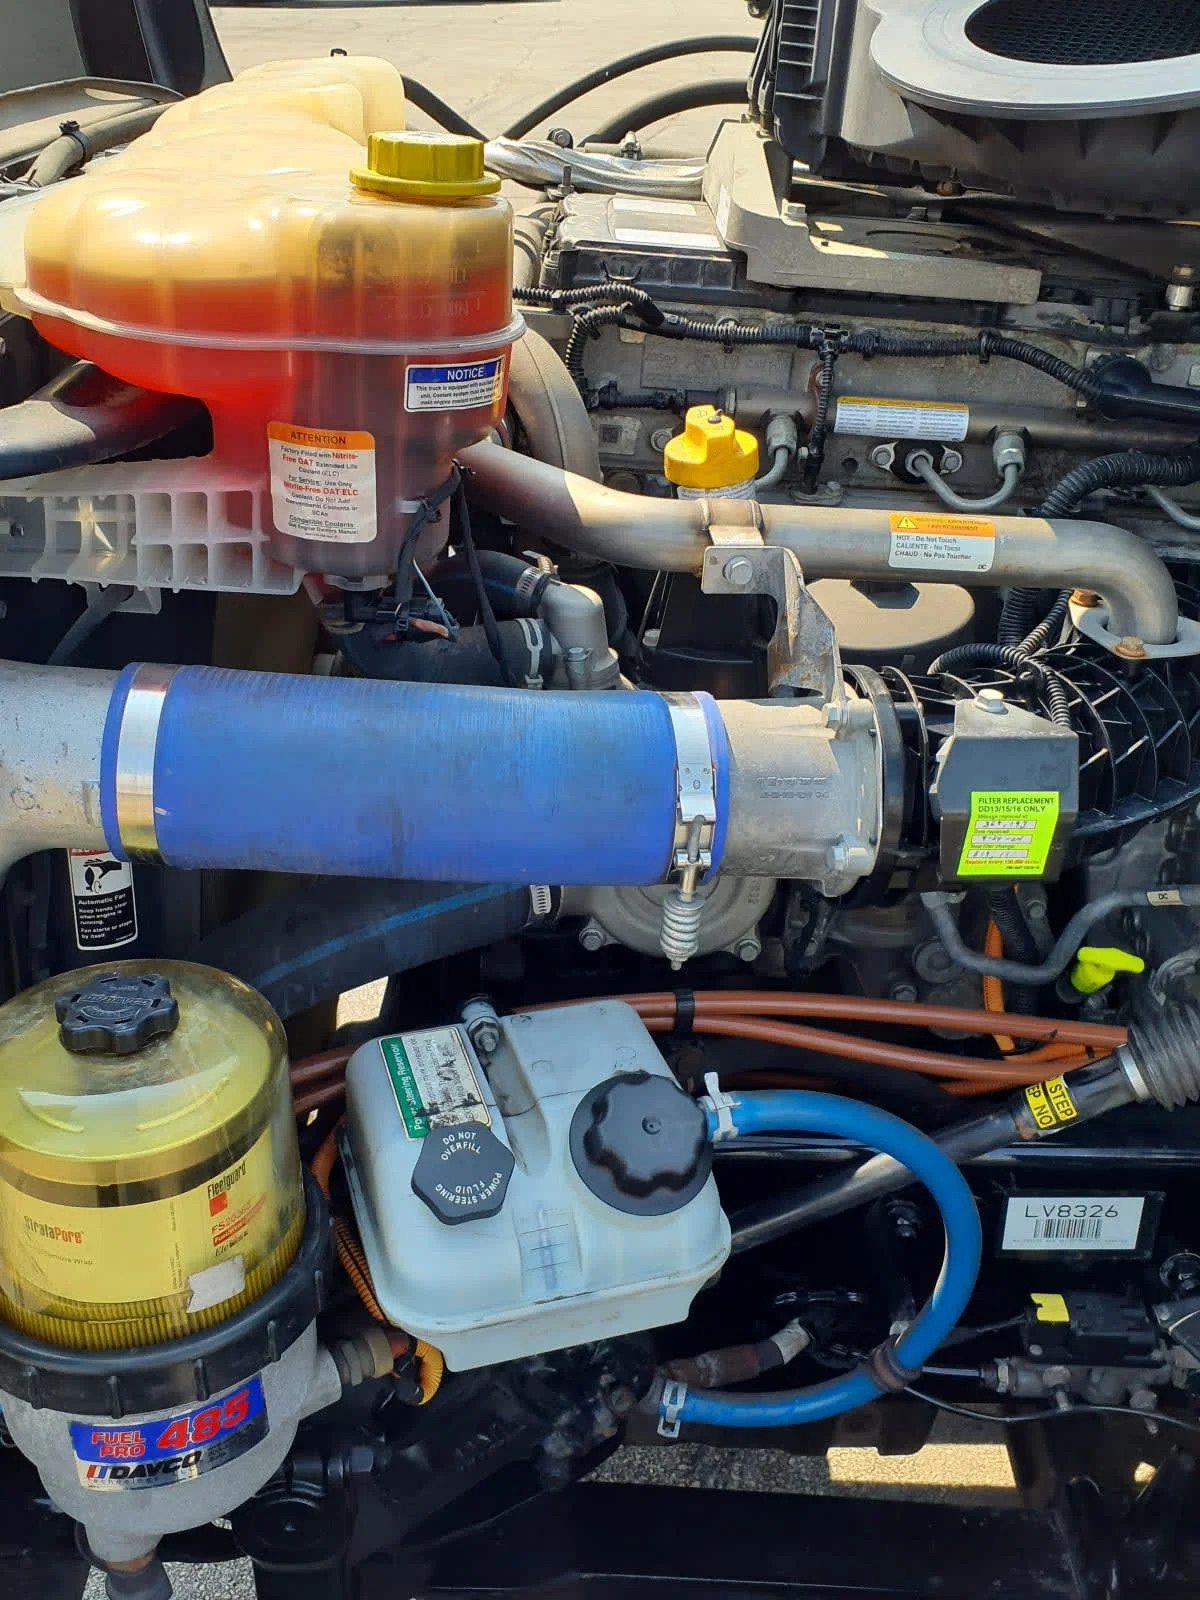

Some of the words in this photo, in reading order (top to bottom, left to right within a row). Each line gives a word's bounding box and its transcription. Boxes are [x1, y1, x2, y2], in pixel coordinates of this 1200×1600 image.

[447, 366, 485, 380] NOTICE
[290, 431, 346, 445] ATTENTION
[282, 454, 297, 463] Free
[298, 457, 314, 466] OAT
[338, 480, 352, 488] Only
[322, 488, 340, 496] OAT
[342, 488, 359, 496] ELC
[78, 896, 113, 905] Automatic
[114, 893, 126, 901] Fan
[118, 920, 133, 928] stops
[390, 1043, 407, 1076] Reservoir
[400, 1074, 417, 1106] Steering
[1049, 1083, 1074, 1116] STEP
[1034, 1104, 1052, 1125] NO
[442, 1134, 455, 1146] DO
[458, 1131, 476, 1140] NOT
[440, 1141, 480, 1161] OVERFILL
[208, 1160, 246, 1200] Fleetguard
[455, 1180, 486, 1194] FLUID
[480, 1172, 502, 1200] POWER
[435, 1184, 478, 1205] STEERING
[1024, 1204, 1119, 1218] LV8326
[156, 1390, 250, 1450] 485
[92, 1430, 146, 1446] FUEL
[100, 1443, 146, 1458] PRO
[109, 1450, 202, 1480] DAVCO
